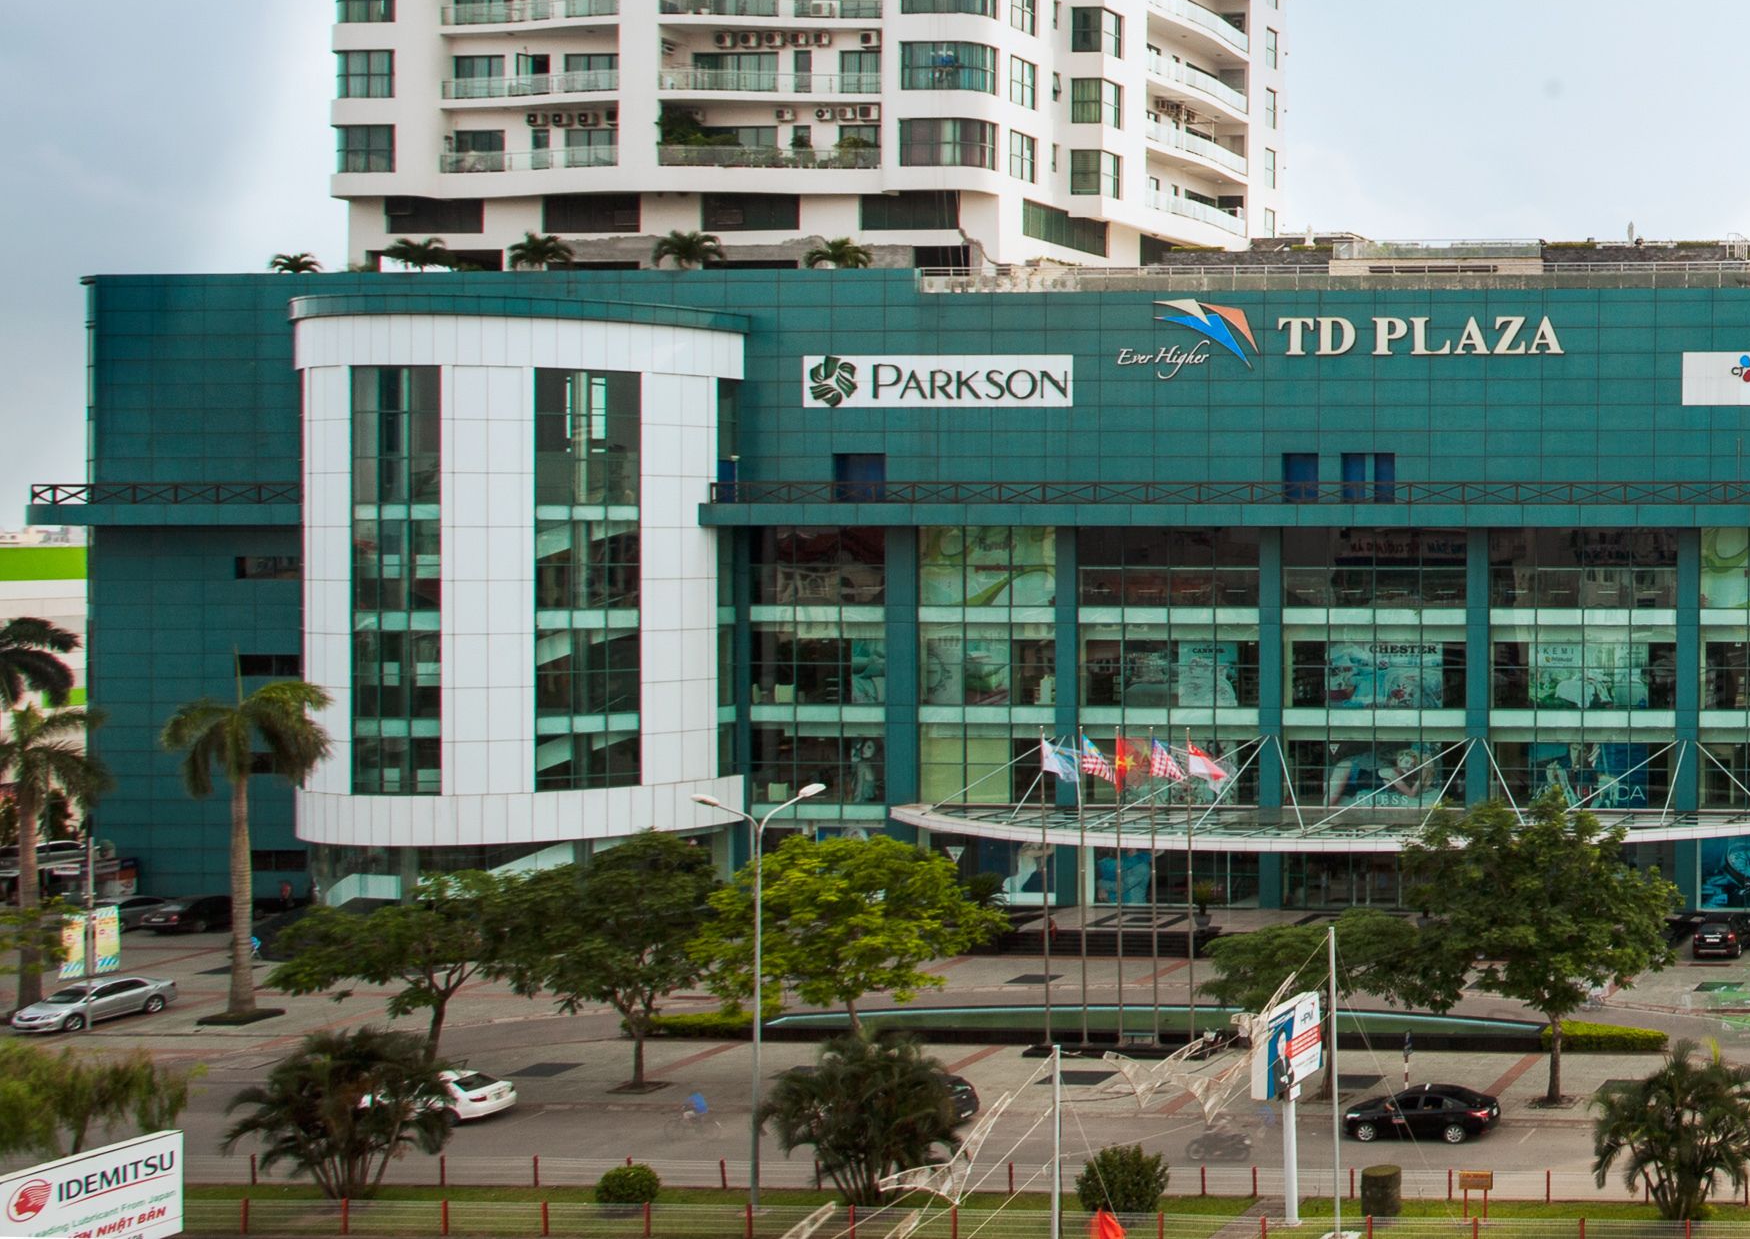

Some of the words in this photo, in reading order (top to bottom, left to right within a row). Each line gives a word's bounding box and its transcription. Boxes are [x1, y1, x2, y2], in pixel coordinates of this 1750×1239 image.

[1278, 317, 1355, 355] TD
[1372, 315, 1565, 356] PLAZA
[1117, 348, 1154, 367] Ever
[1155, 339, 1209, 380] Higher
[1731, 366, 1745, 377] CJ
[872, 362, 1068, 400] PARKSON
[1369, 644, 1437, 654] CHESTER
[58, 1151, 174, 1202] IDEMITSU
[72, 1207, 118, 1228] Lubricant
[121, 1200, 146, 1212] From
[148, 1190, 176, 1205] Japan
[96, 1215, 133, 1237] NHẬT
